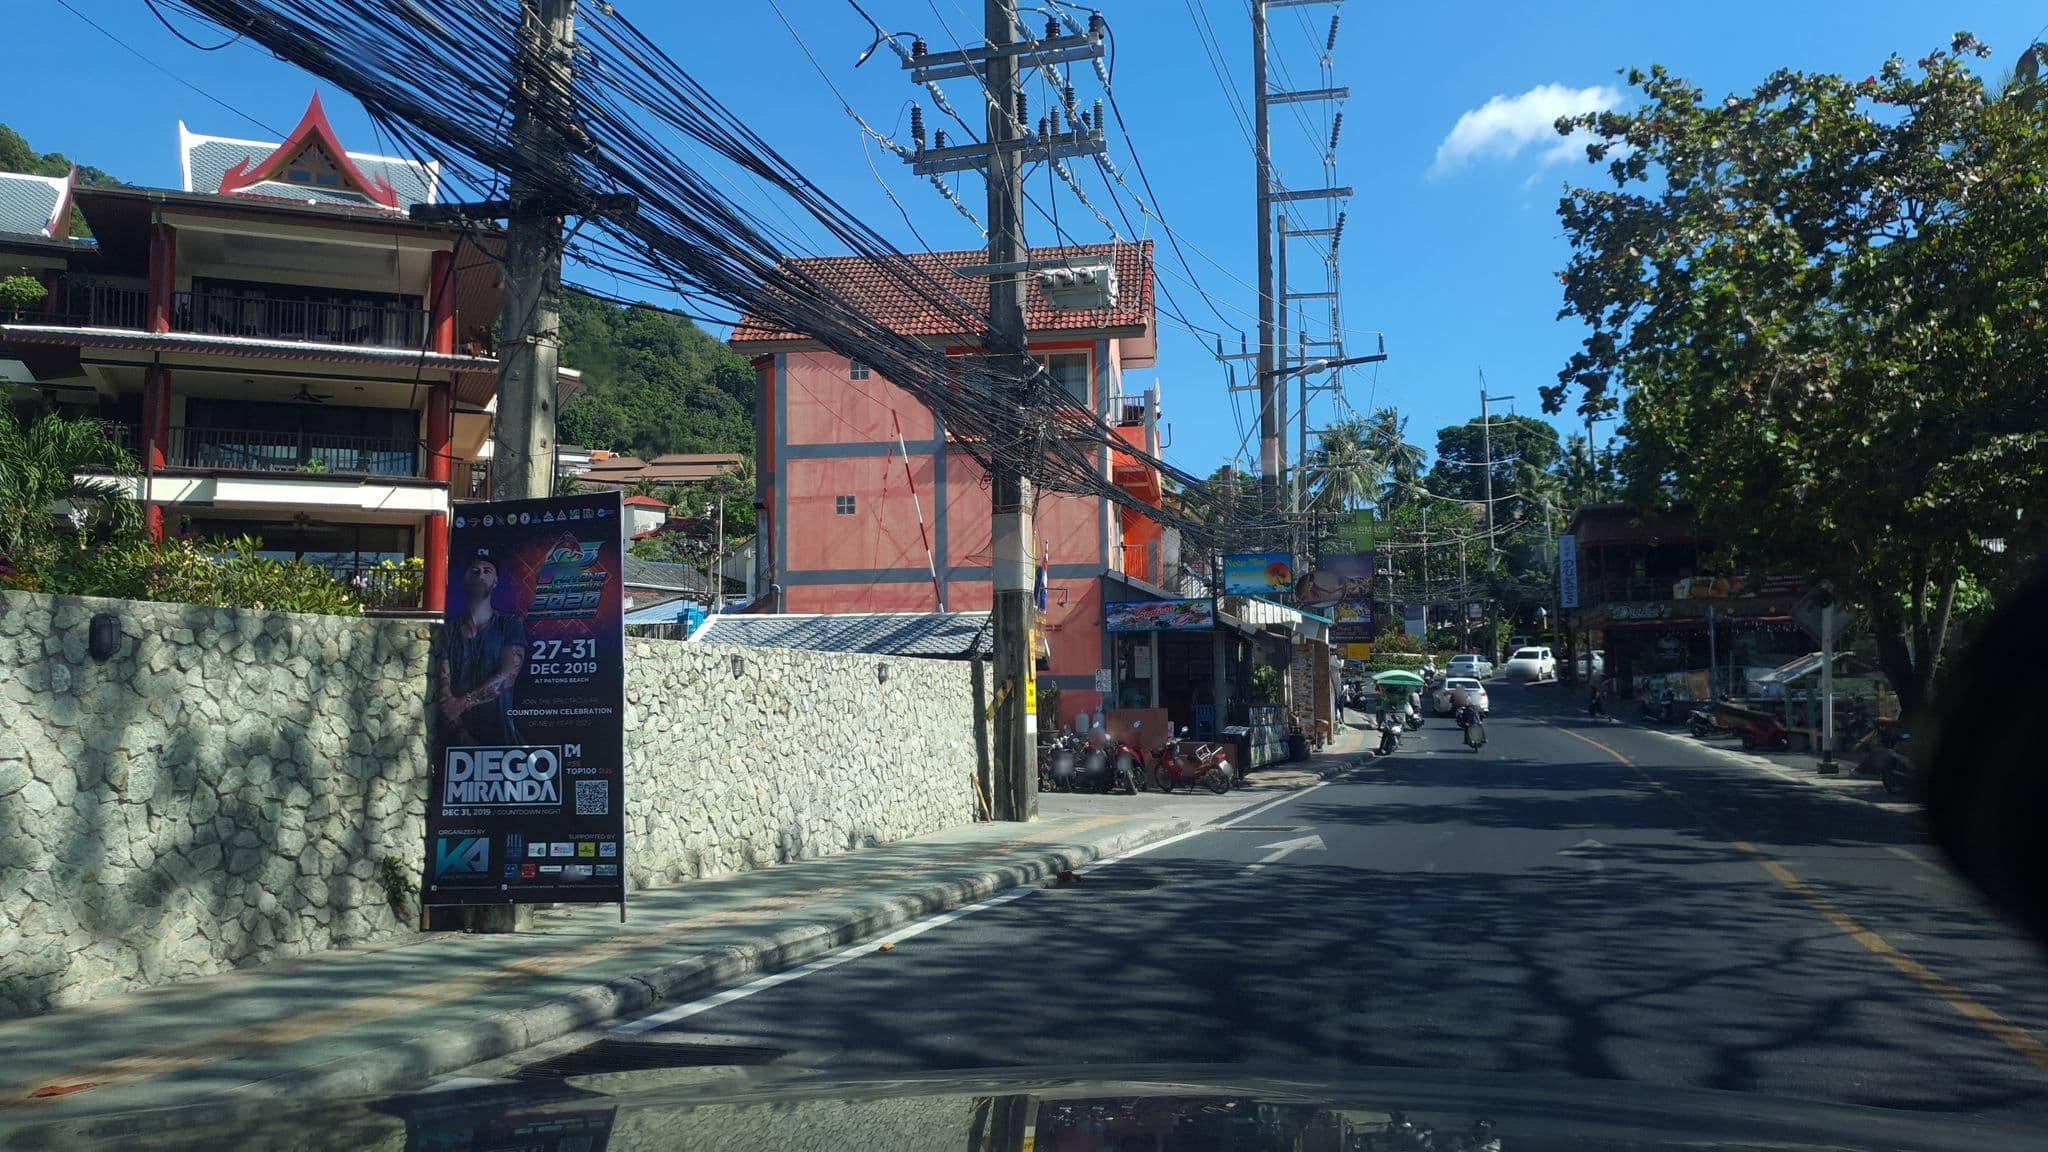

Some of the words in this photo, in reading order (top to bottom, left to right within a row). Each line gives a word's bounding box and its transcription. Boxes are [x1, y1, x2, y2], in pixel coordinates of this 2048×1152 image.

[1340, 526, 1391, 534] PHARMACY
[529, 592, 601, 611] 2020
[531, 638, 597, 660] 27-31
[530, 663, 560, 675] DEC
[563, 661, 598, 674] 2019
[506, 708, 559, 717] COUNTDOWN
[560, 706, 613, 716] CELEBRATION
[448, 748, 559, 782] DIEGO
[565, 767, 598, 775] TOP100
[446, 780, 558, 803] MIRANDA
[442, 808, 460, 817] DEC
[473, 808, 492, 816] 2019
[497, 808, 541, 816] COUNTDOWN
